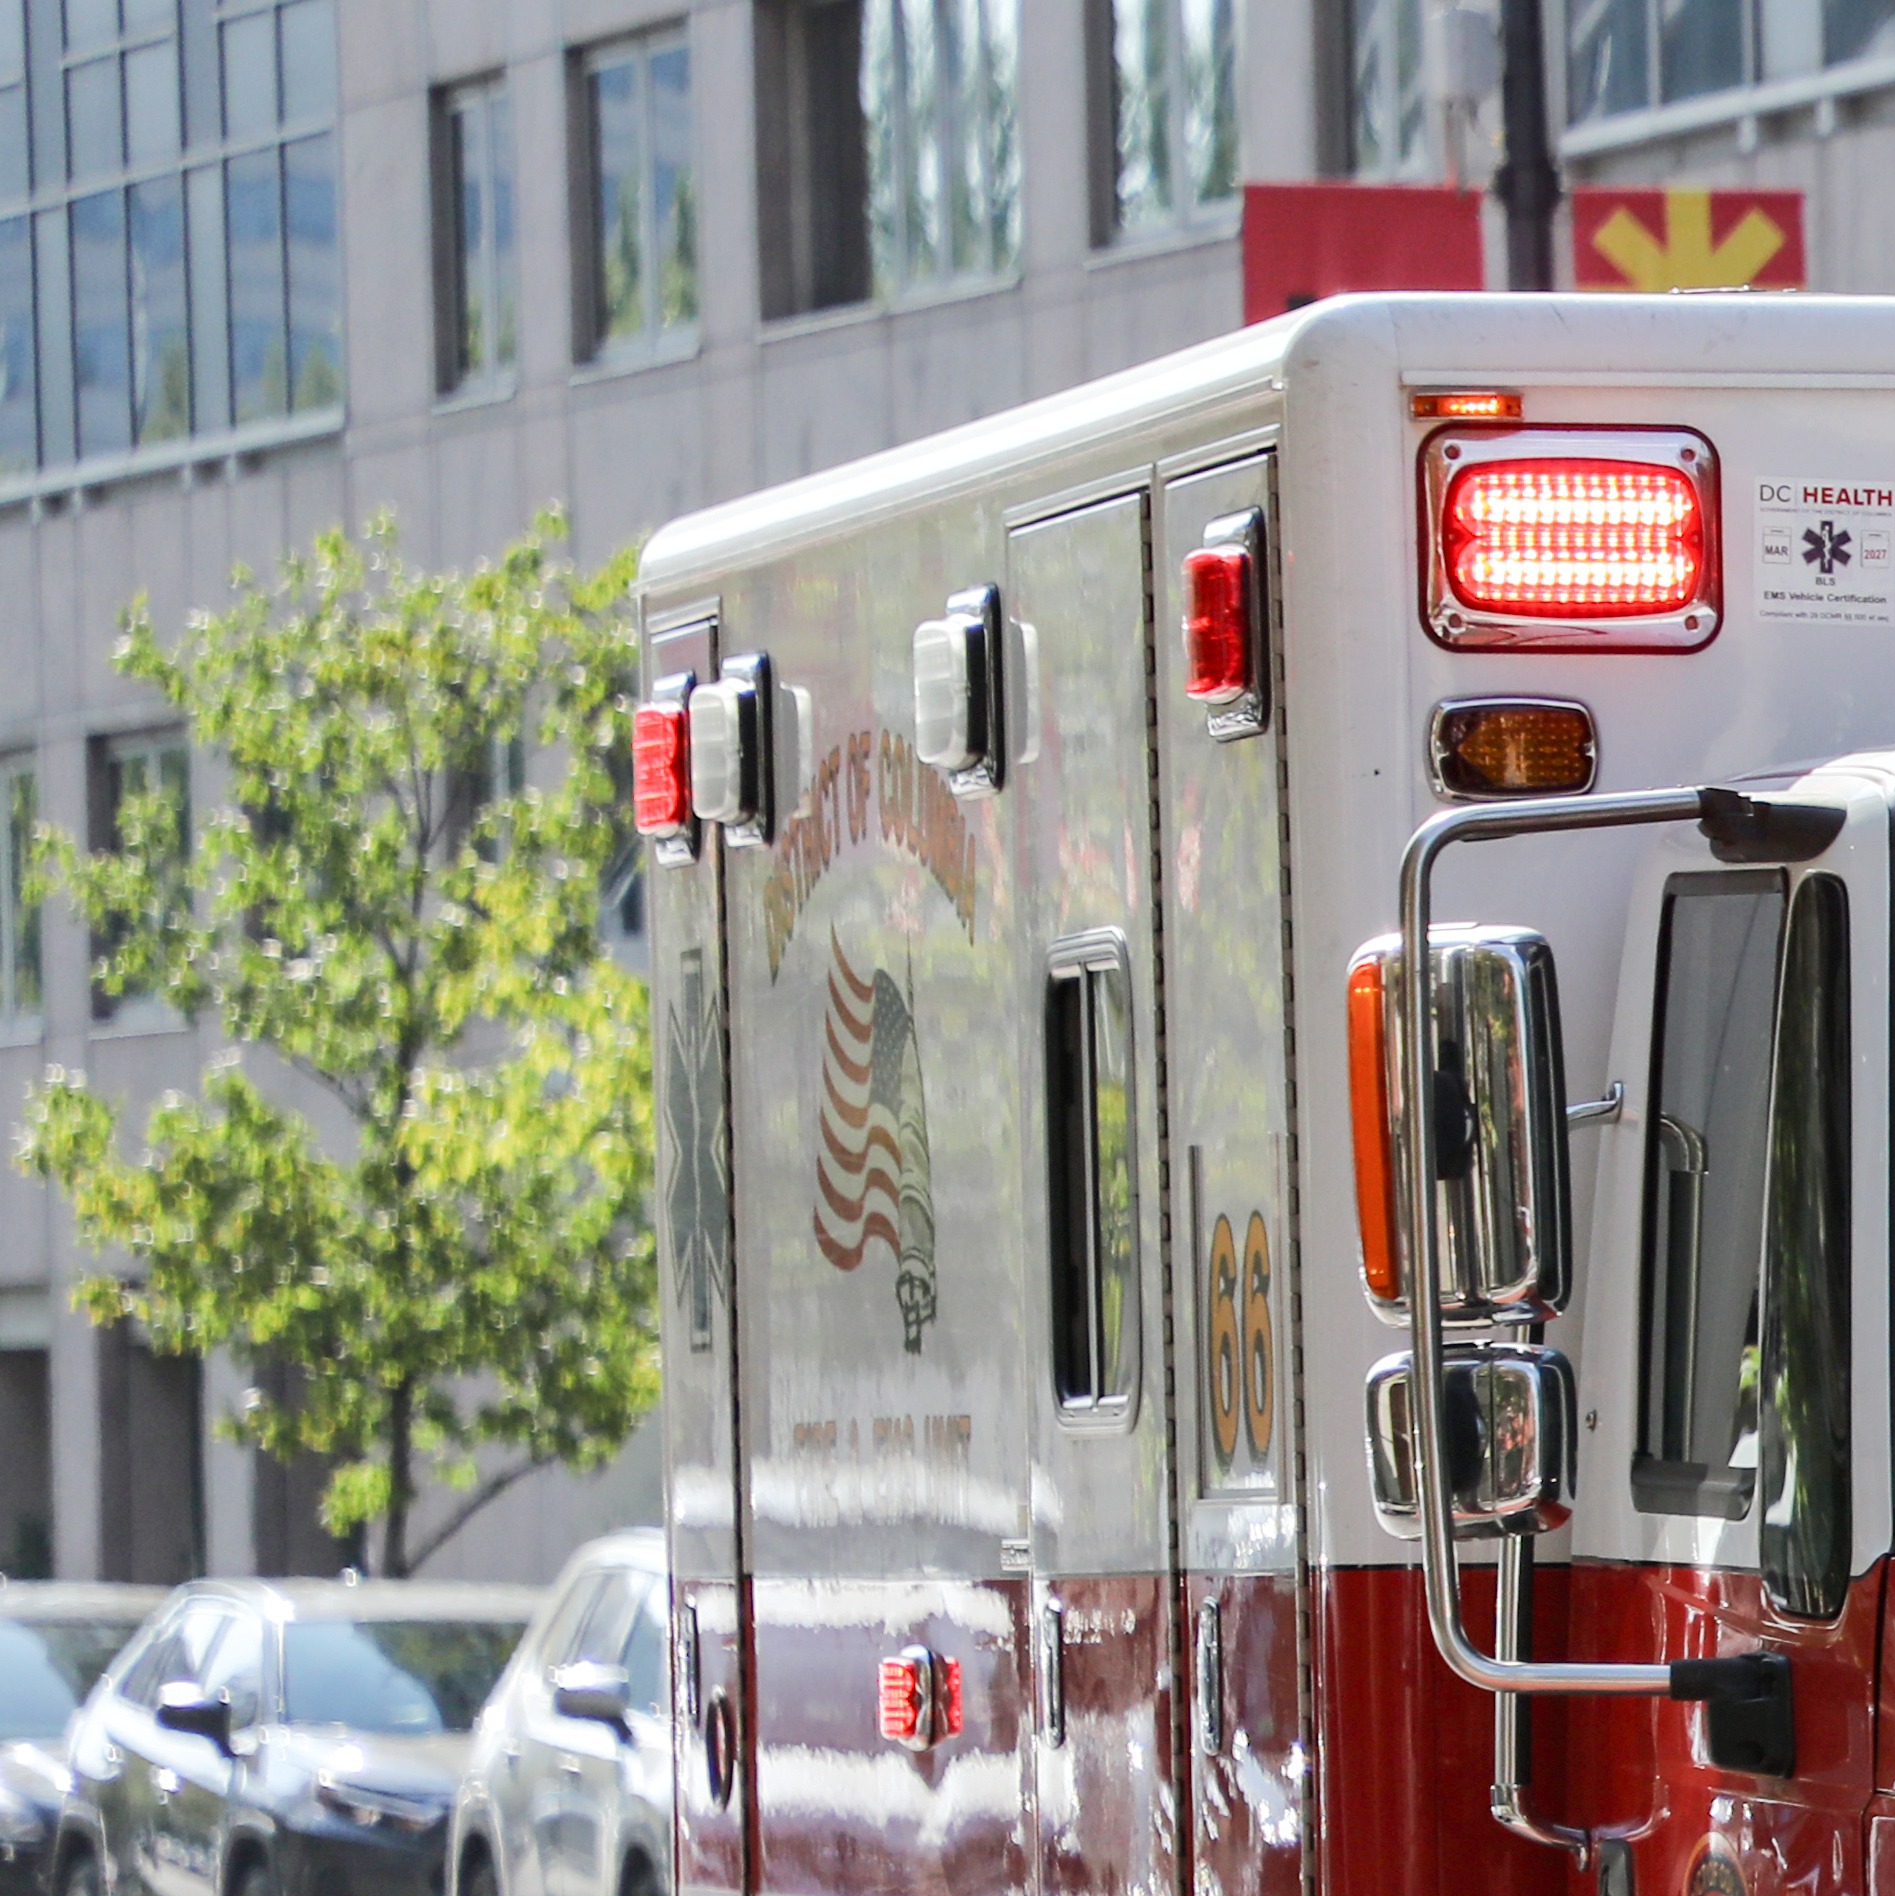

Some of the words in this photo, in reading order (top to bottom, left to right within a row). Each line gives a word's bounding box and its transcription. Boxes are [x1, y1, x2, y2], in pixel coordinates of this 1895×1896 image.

[1760, 484, 1791, 502] DC
[1803, 486, 1892, 506] HEALTH
[1765, 545, 1789, 556] MAR
[1864, 549, 1887, 560] 2027
[1815, 577, 1836, 586] BLS
[1763, 590, 1786, 600] EMS
[1789, 592, 1824, 601] Vehicle
[1826, 593, 1888, 603] Certification
[847, 731, 871, 846] OF
[1208, 1210, 1274, 1476] 66
